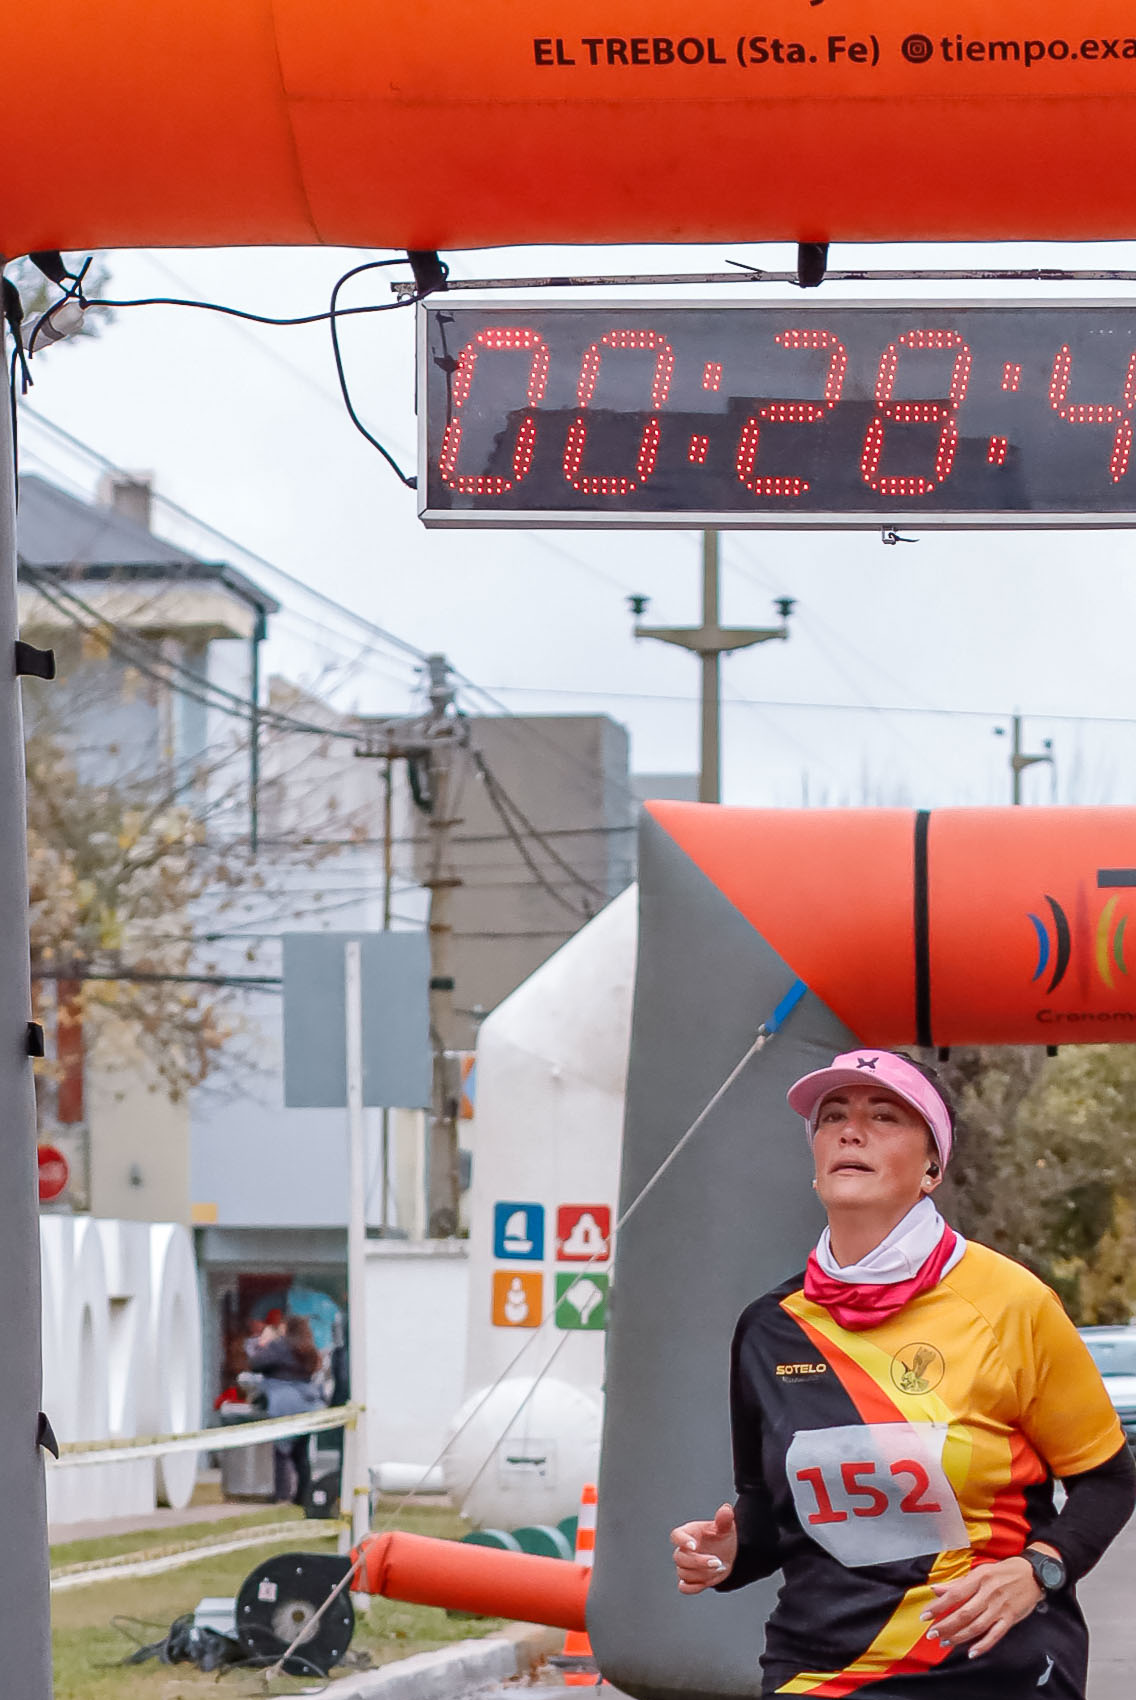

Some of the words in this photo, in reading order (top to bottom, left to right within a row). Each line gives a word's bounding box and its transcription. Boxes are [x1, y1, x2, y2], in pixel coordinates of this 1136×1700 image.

[533, 38, 576, 66] EL
[581, 37, 727, 66] TREBOL
[736, 36, 818, 68] (Sta.
[827, 34, 881, 67] Fe)
[775, 1363, 827, 1376] SOTELO
[796, 1458, 942, 1525] 152
